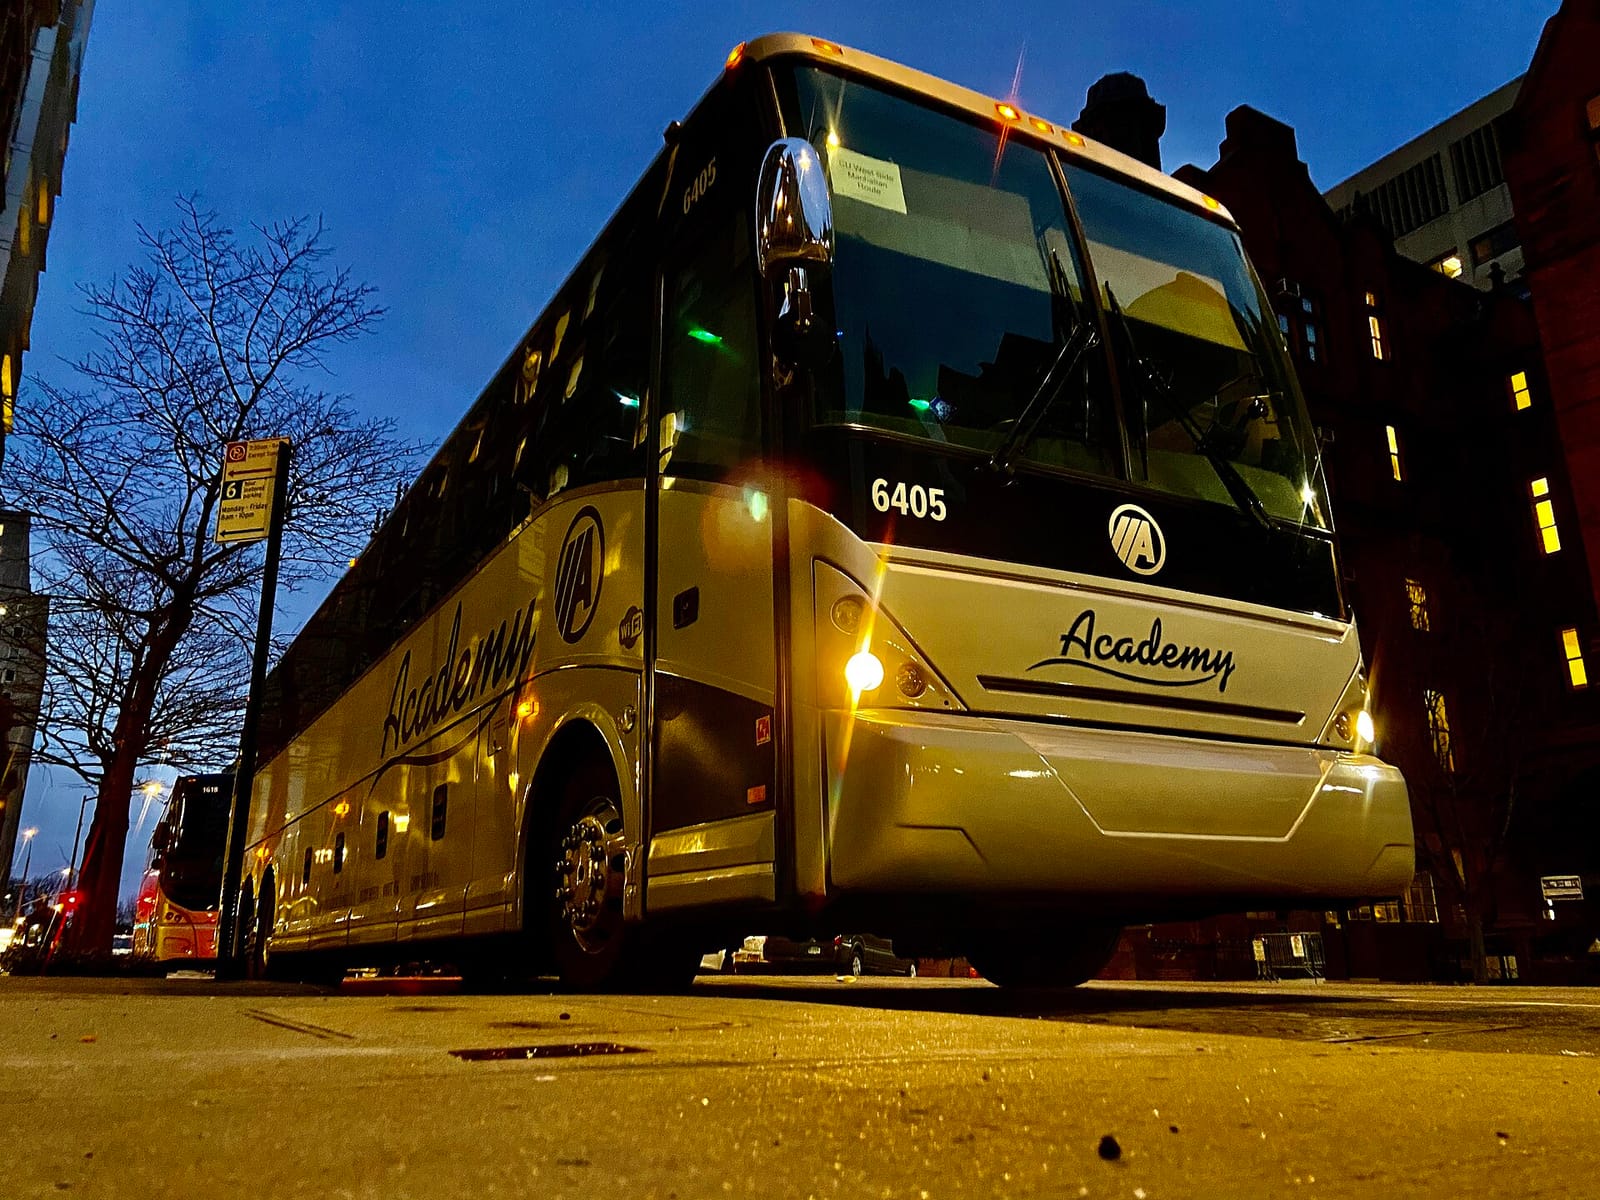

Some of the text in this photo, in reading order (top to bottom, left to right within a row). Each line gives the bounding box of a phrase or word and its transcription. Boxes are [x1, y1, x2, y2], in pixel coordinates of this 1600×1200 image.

[683, 155, 717, 214] 6405
[221, 505, 245, 513] Monday
[249, 502, 269, 510] Friday
[226, 481, 237, 499] 6
[871, 477, 947, 522] 6405
[1059, 609, 1236, 693] Academy
[380, 597, 537, 759] Academy
